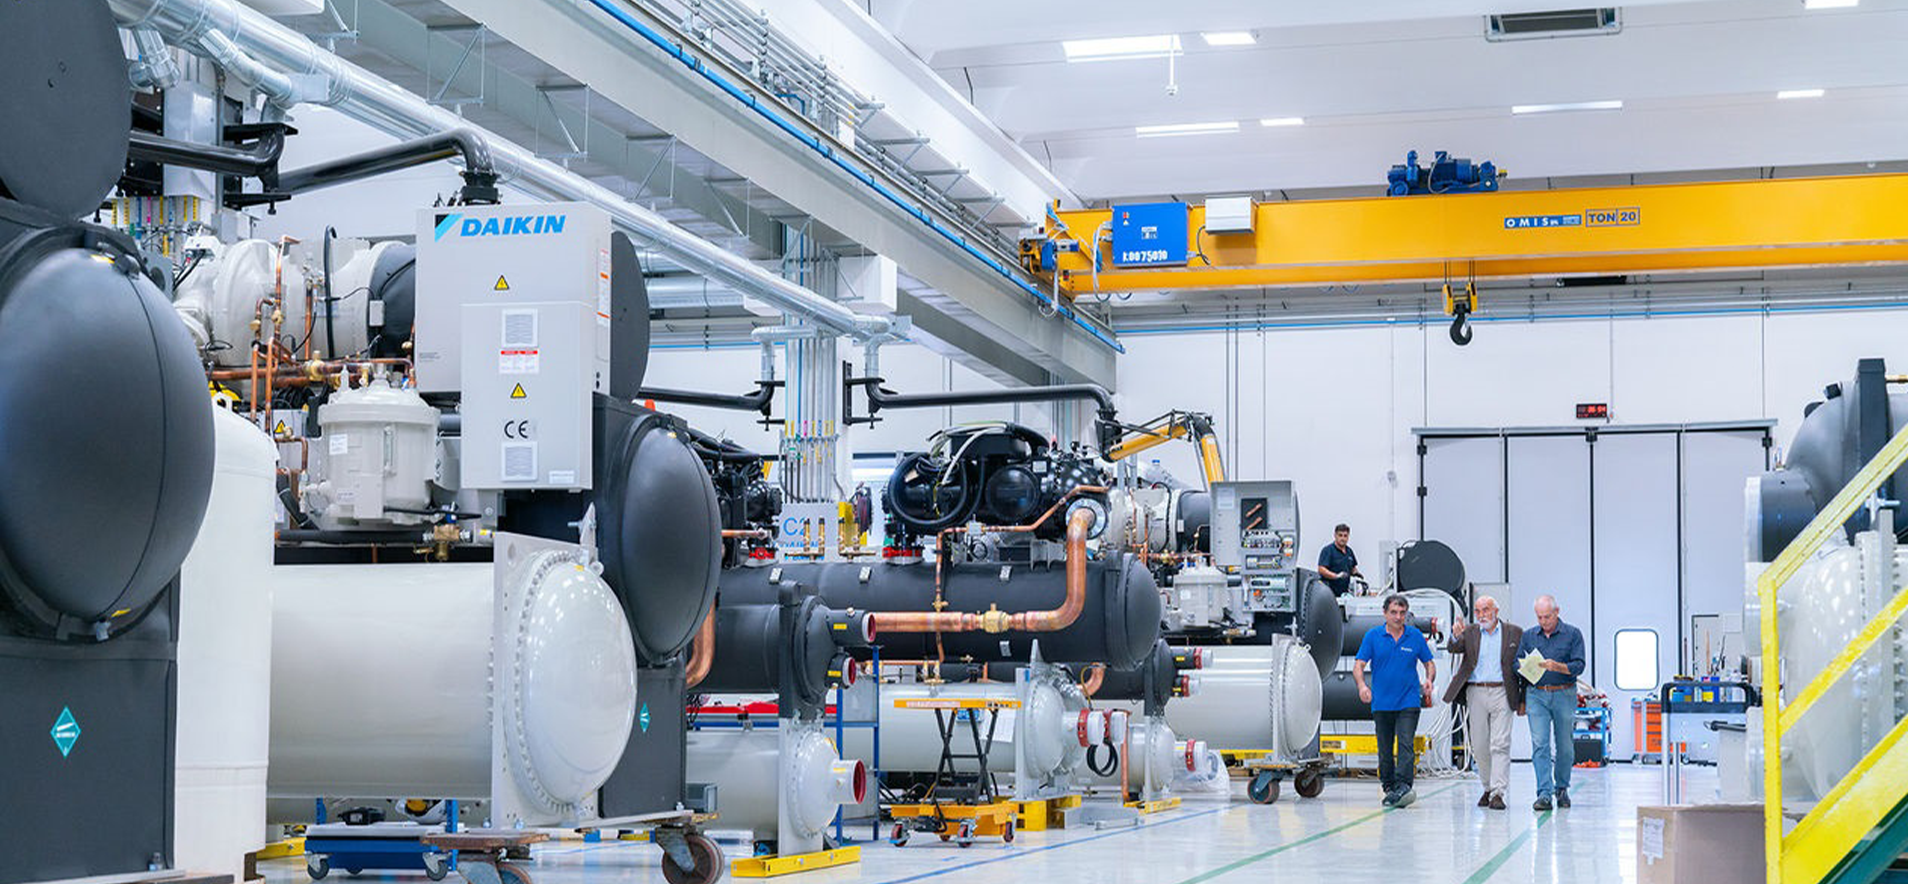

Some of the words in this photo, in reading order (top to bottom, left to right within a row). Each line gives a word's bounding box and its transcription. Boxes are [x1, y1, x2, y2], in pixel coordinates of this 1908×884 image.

[1506, 217, 1549, 228] OMIS
[1588, 212, 1615, 223] TON
[1620, 211, 1637, 222] 20
[460, 215, 566, 237] DAIKIN
[504, 420, 528, 439] CE
